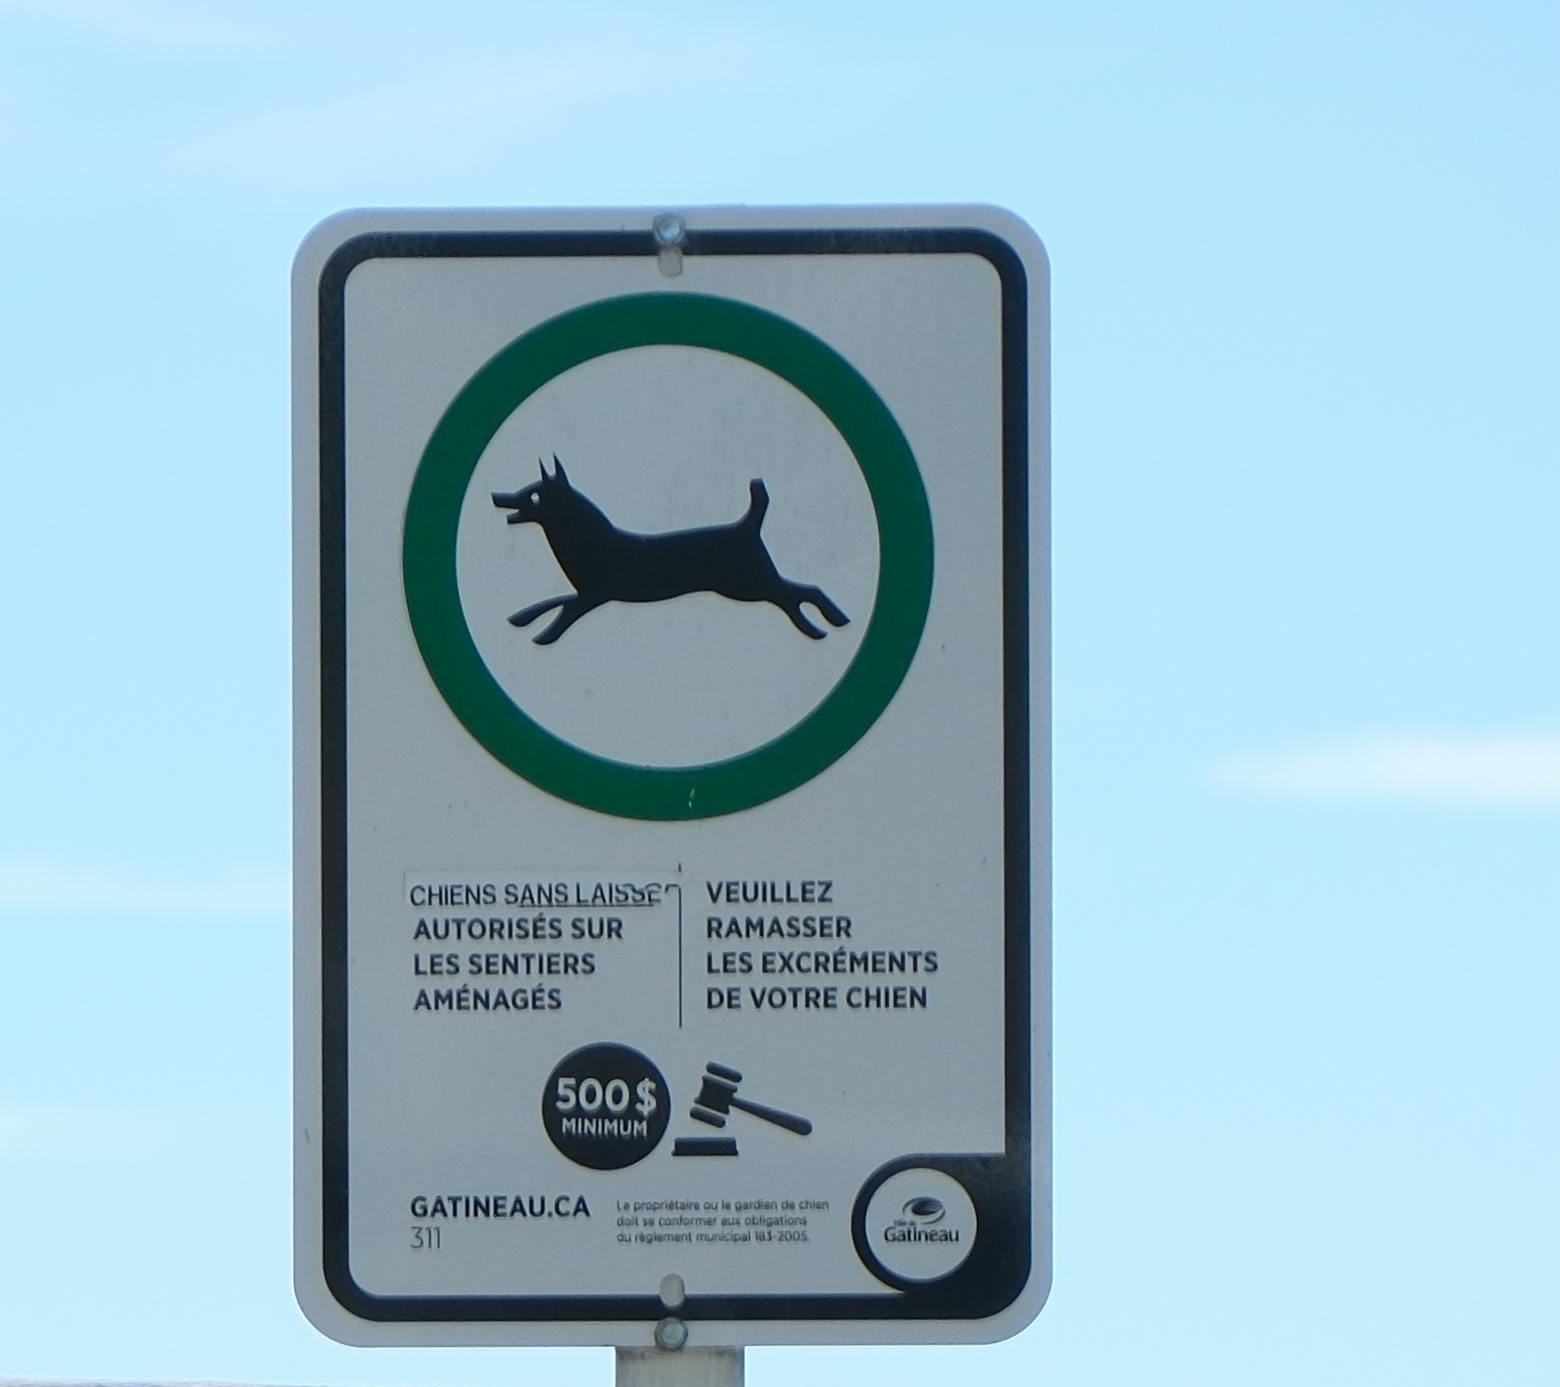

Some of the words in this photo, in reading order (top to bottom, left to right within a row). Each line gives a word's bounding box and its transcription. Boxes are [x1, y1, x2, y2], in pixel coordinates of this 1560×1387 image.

[409, 884, 497, 907] CHIENS
[504, 883, 569, 906] SANS
[707, 881, 834, 903] VEUILLEZ
[413, 912, 564, 941] AUTORISÉS
[571, 917, 623, 940] SUR
[707, 916, 852, 938] RAMASSER
[414, 954, 461, 976] LES
[468, 953, 596, 976] SENTIERS
[707, 952, 754, 974] LES
[761, 946, 939, 974] EXCRÉMENTS
[413, 982, 563, 1011] AMÉNAGÉS
[707, 988, 743, 1010] DE
[748, 988, 839, 1010] VOTRE
[846, 987, 928, 1010] CHIEN
[562, 1117, 649, 1137] MINIMUM
[410, 1195, 591, 1218] GATINEAU.CA
[617, 1200, 631, 1211] Le
[634, 1199, 700, 1212] propriétaire
[735, 1199, 778, 1212] gardien
[744, 1215, 808, 1227] obligations
[410, 1226, 441, 1249] 311
[884, 1226, 960, 1243] Gatineau
